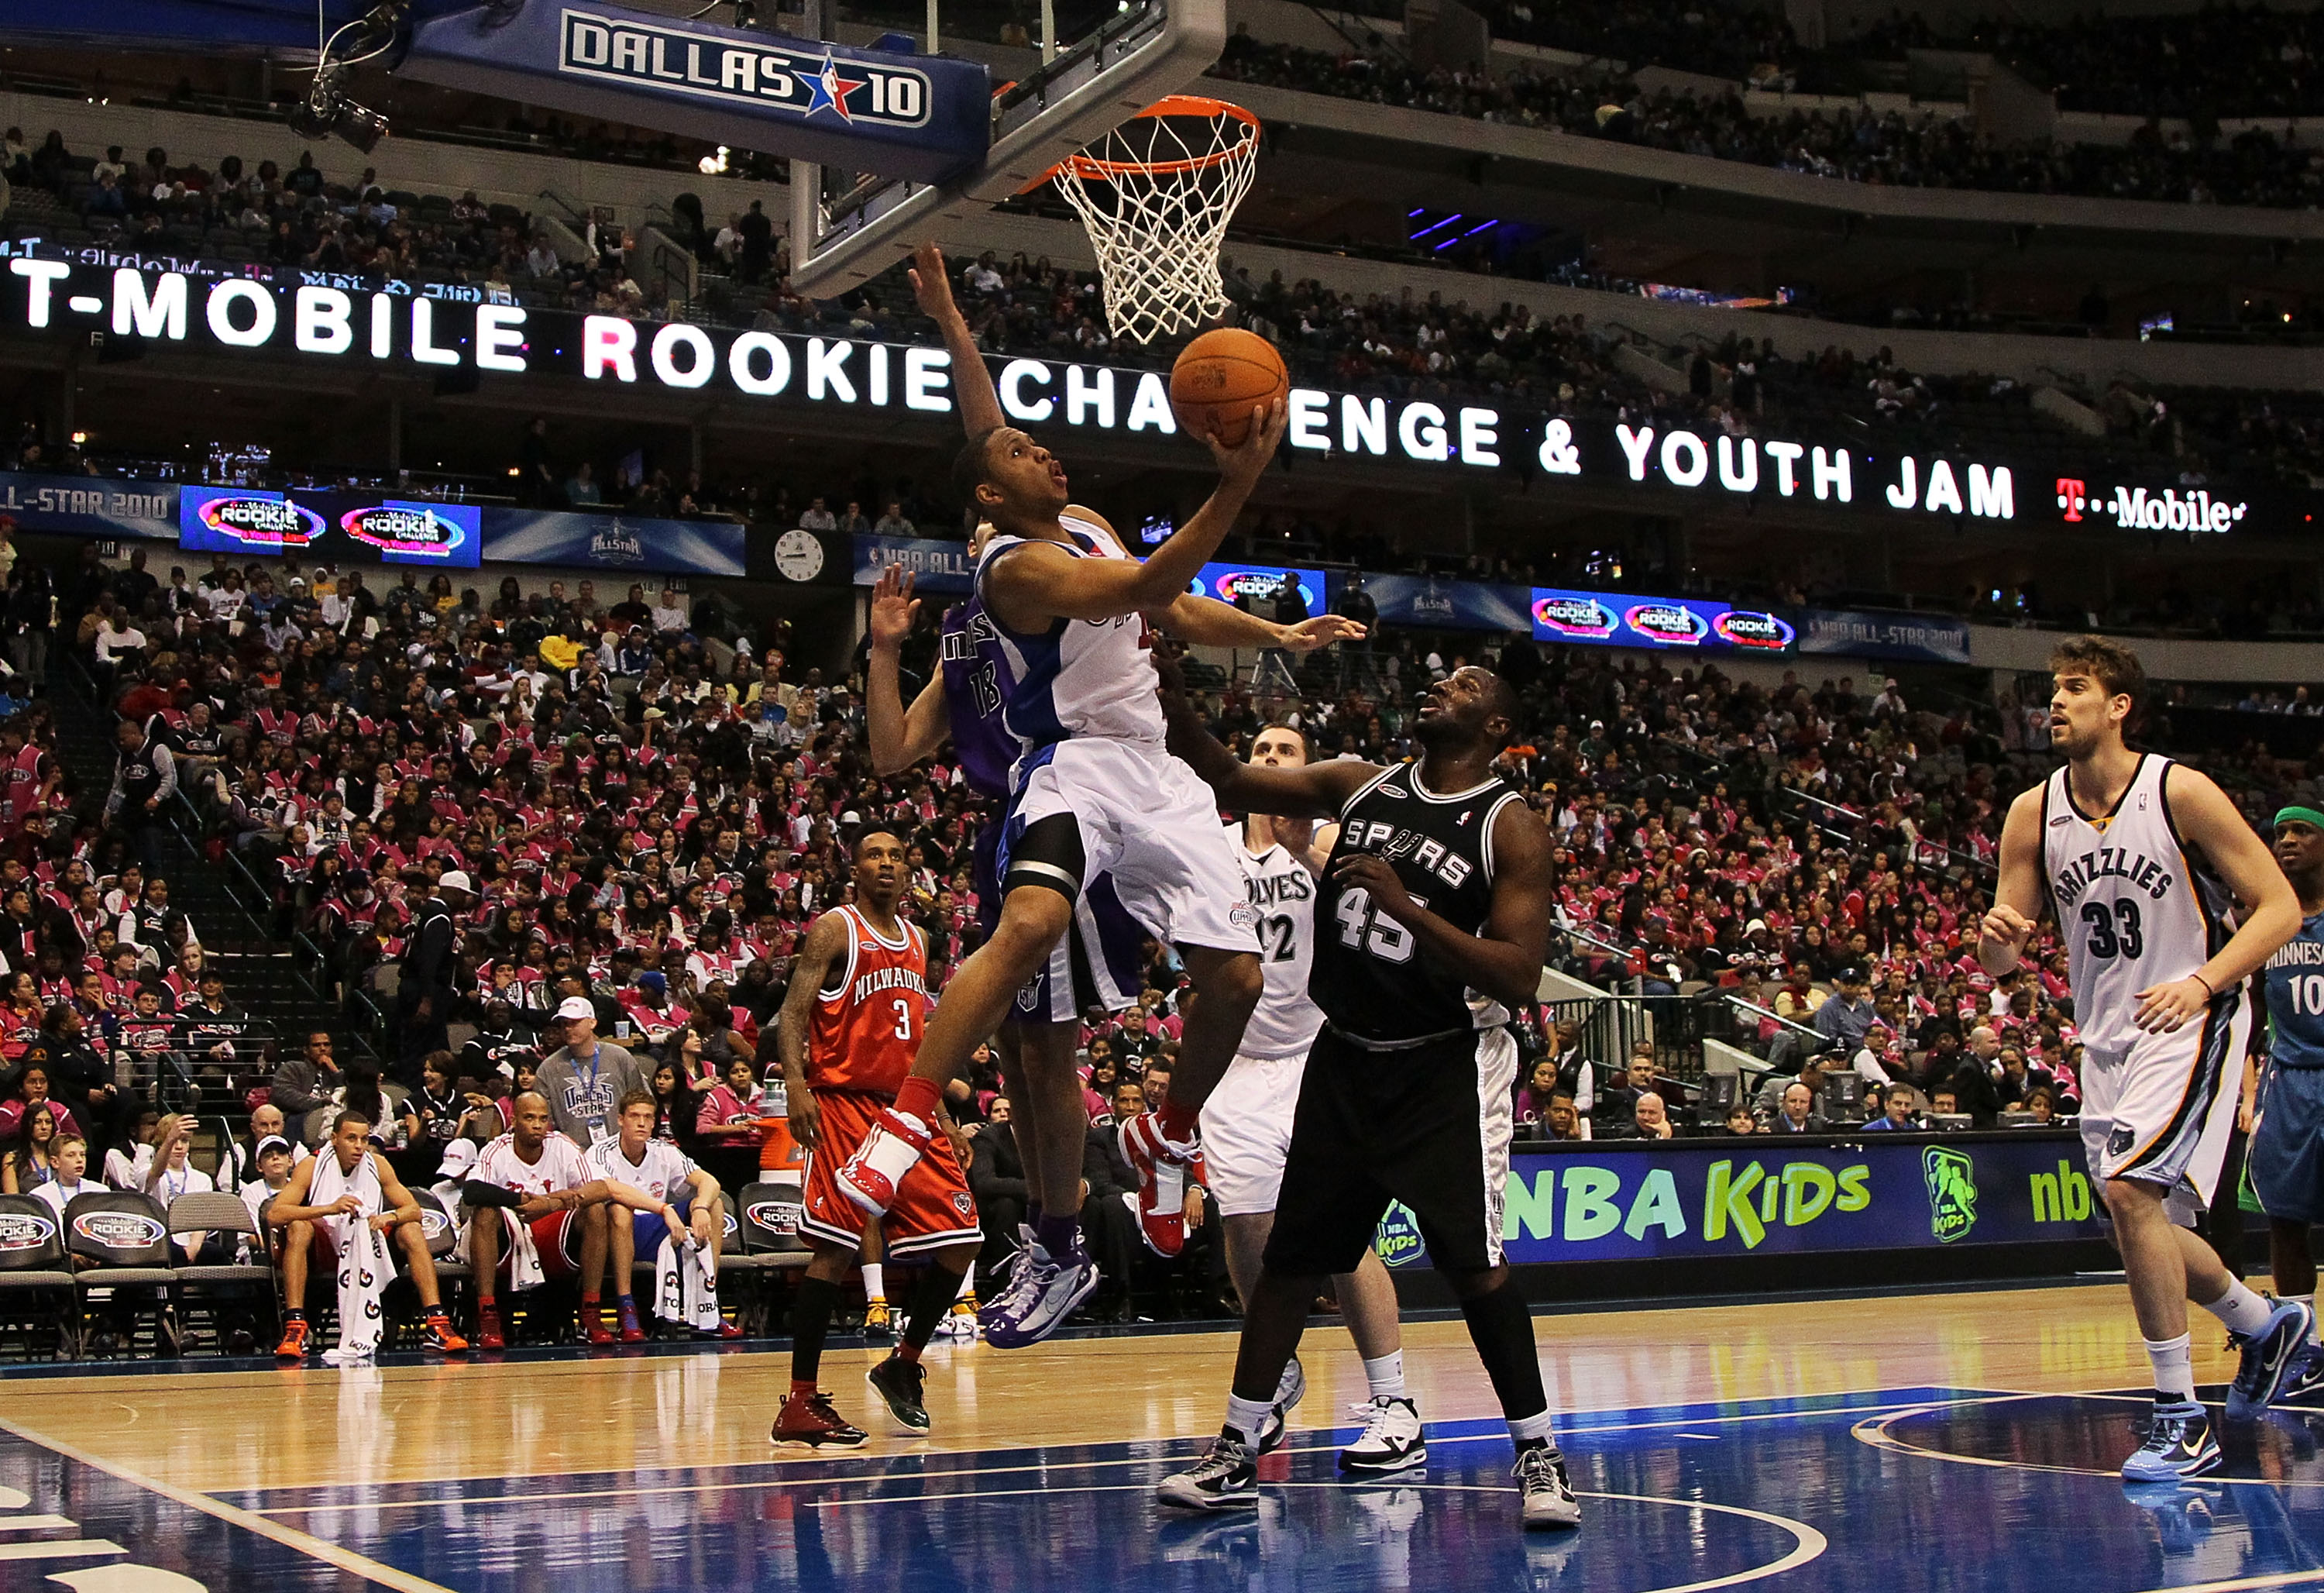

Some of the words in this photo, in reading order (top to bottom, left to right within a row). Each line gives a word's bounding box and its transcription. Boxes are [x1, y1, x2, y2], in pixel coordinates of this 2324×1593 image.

[572, 22, 793, 98] DALLAS
[868, 72, 921, 117] 10
[9, 257, 528, 372] T-MOBILE
[583, 315, 952, 412] ROOKIE
[999, 360, 1501, 466] CHAENGE
[1539, 419, 1581, 474] &
[1616, 425, 1851, 503] YOUTH
[1886, 456, 2014, 518] JAM
[4, 486, 104, 514] L-STAR
[112, 493, 168, 518] 2010
[221, 507, 298, 525] ROOKIE
[363, 517, 438, 534] ROOKIE
[883, 549, 925, 573] NBA
[1547, 606, 1602, 619] ROOKIE
[1639, 612, 1690, 625] ROOKIE
[1726, 620, 1776, 634] ROOKIE
[968, 660, 1002, 719] 18
[1344, 817, 1474, 889] SPURS
[1243, 870, 1312, 908] OLVES
[2054, 848, 2172, 907] GRIZZLIES
[1334, 886, 1429, 965] 45
[2081, 896, 2144, 960] 33
[2265, 941, 2324, 970] MINNES
[892, 999, 911, 1040] 3
[1502, 1166, 1687, 1241] NBA
[1703, 1159, 1872, 1249] KIDS
[2030, 1159, 2092, 1223] nb
[92, 1223, 148, 1234] ROOKIE
[763, 1212, 799, 1222] ROOK
[1387, 1223, 1408, 1234] NBA
[1933, 1214, 1965, 1233] KIDS
[1379, 1234, 1418, 1256] KIDS
